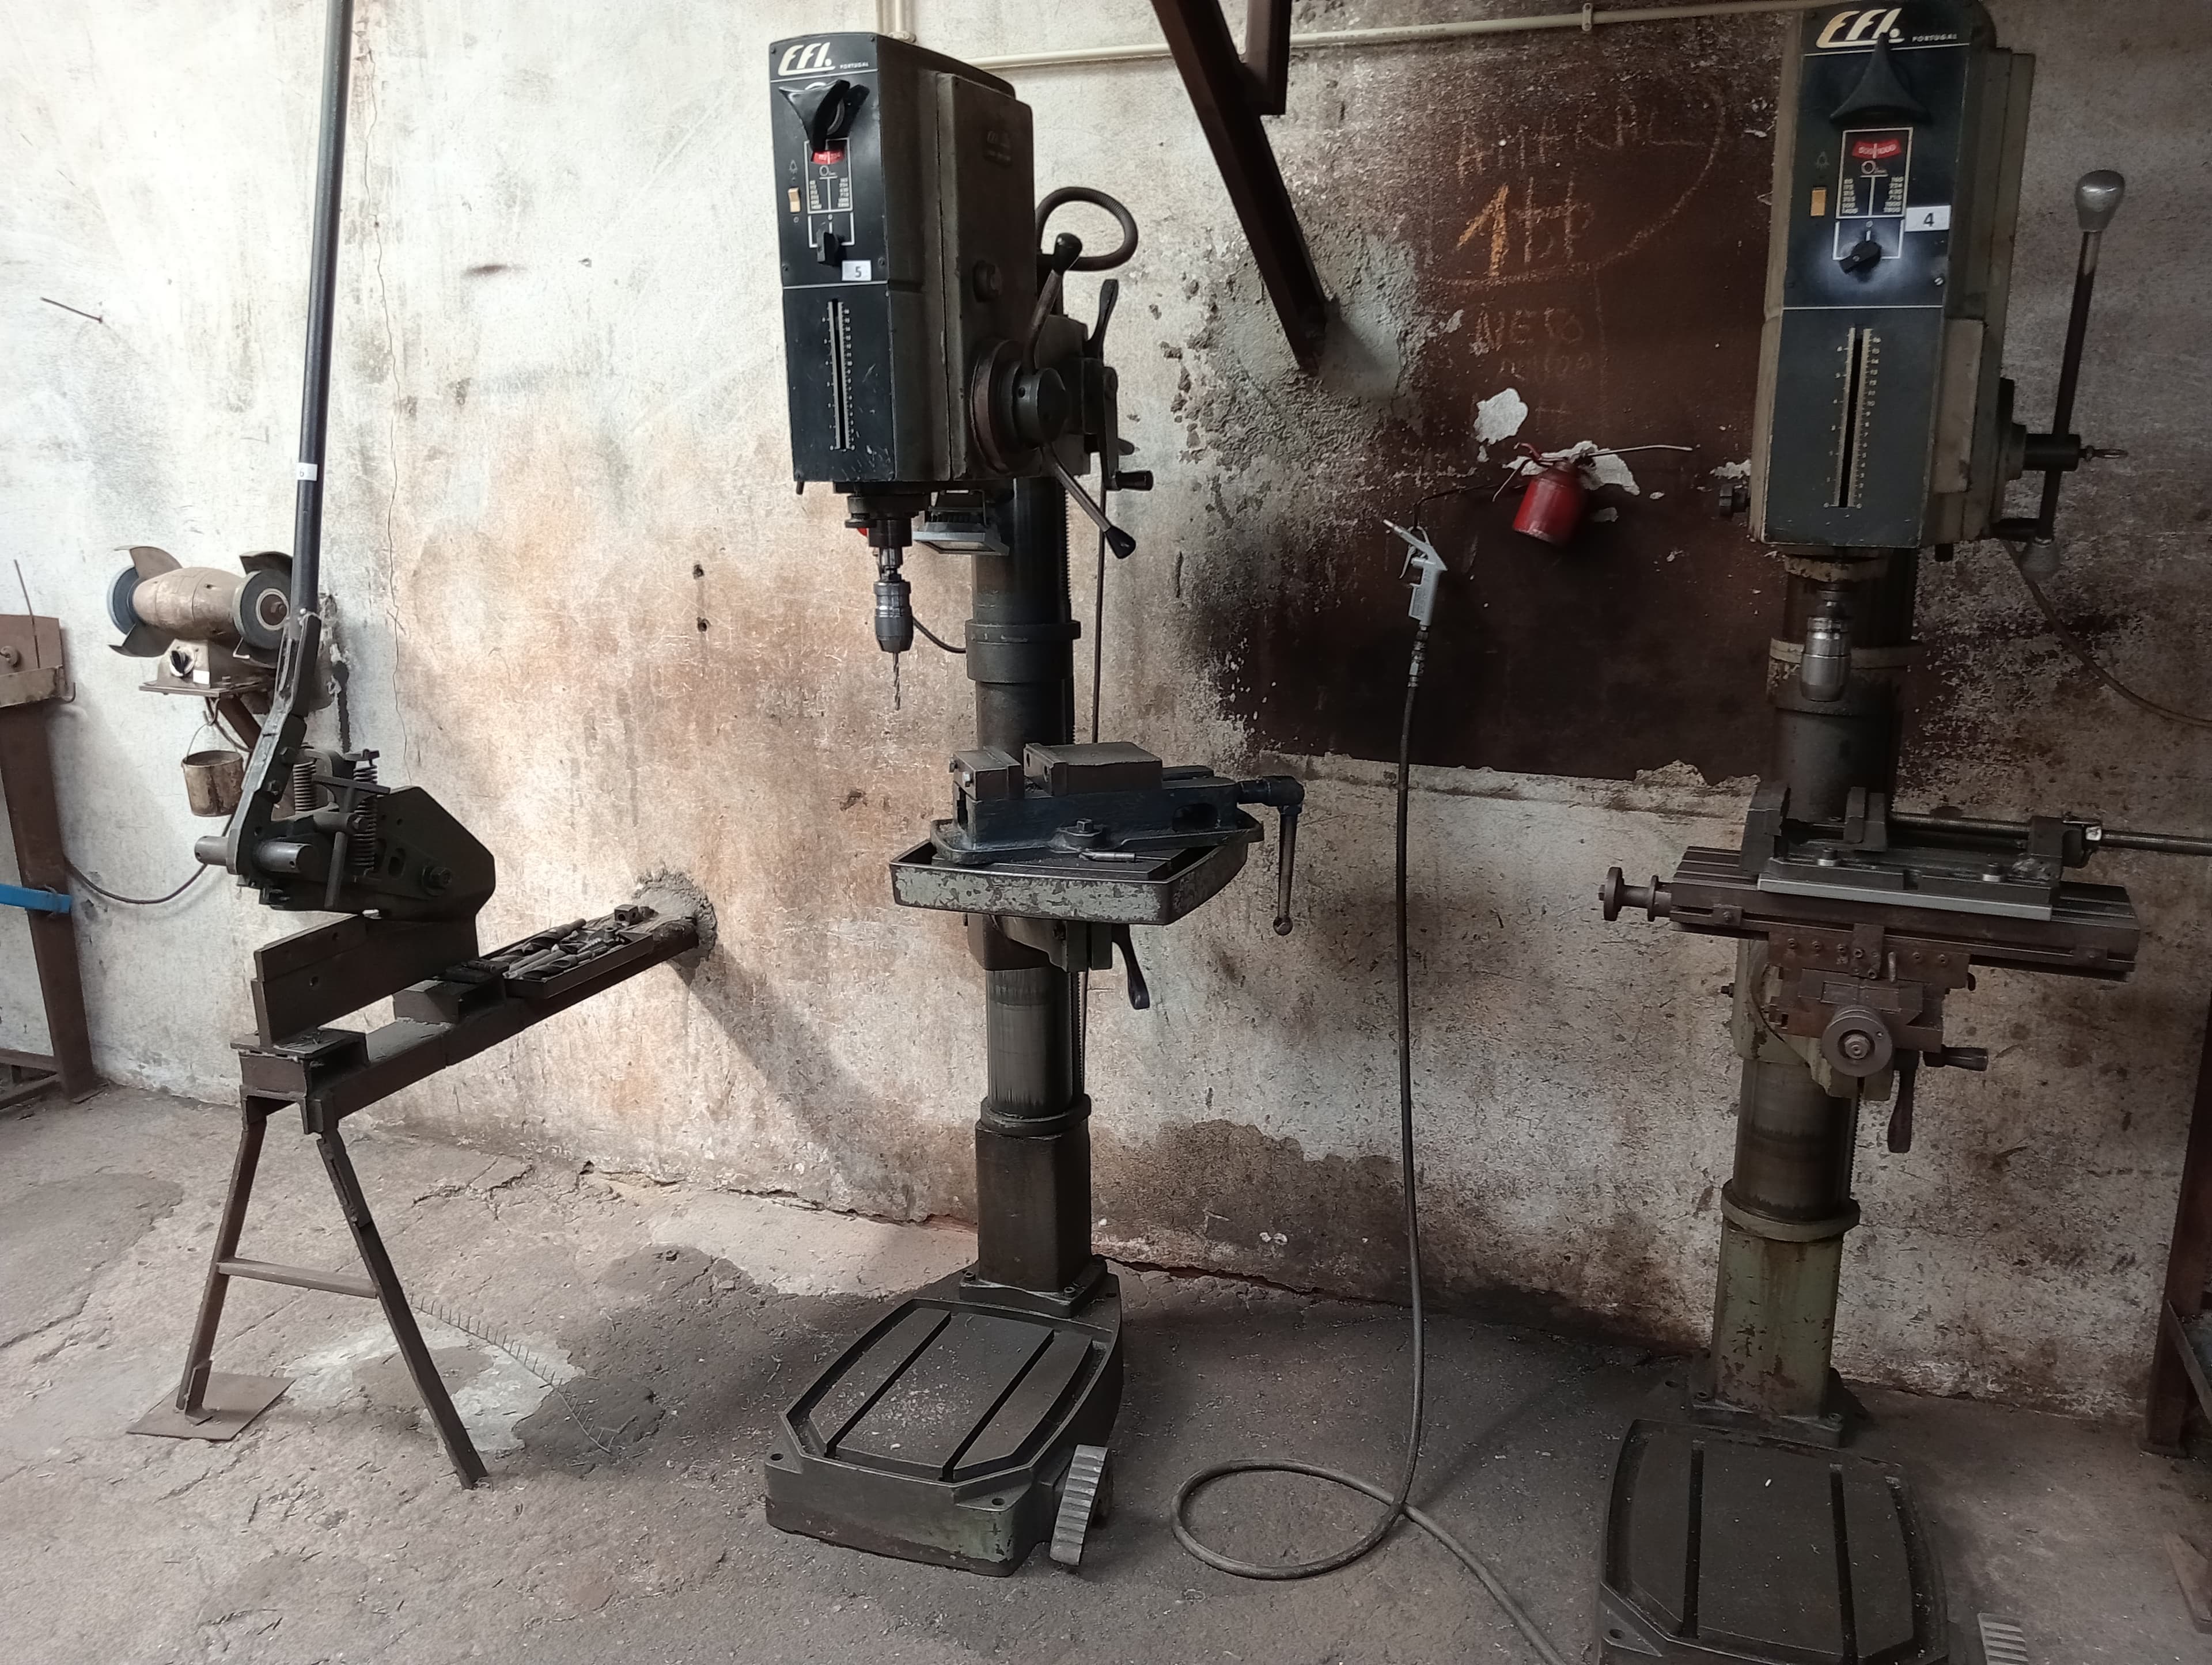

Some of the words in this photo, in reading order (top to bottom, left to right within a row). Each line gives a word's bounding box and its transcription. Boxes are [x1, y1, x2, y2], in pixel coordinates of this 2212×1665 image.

[1911, 33, 1958, 43] PORTUGAL
[1923, 212, 1935, 227] 4
[855, 266, 862, 278] 5
[299, 467, 305, 477] 6
